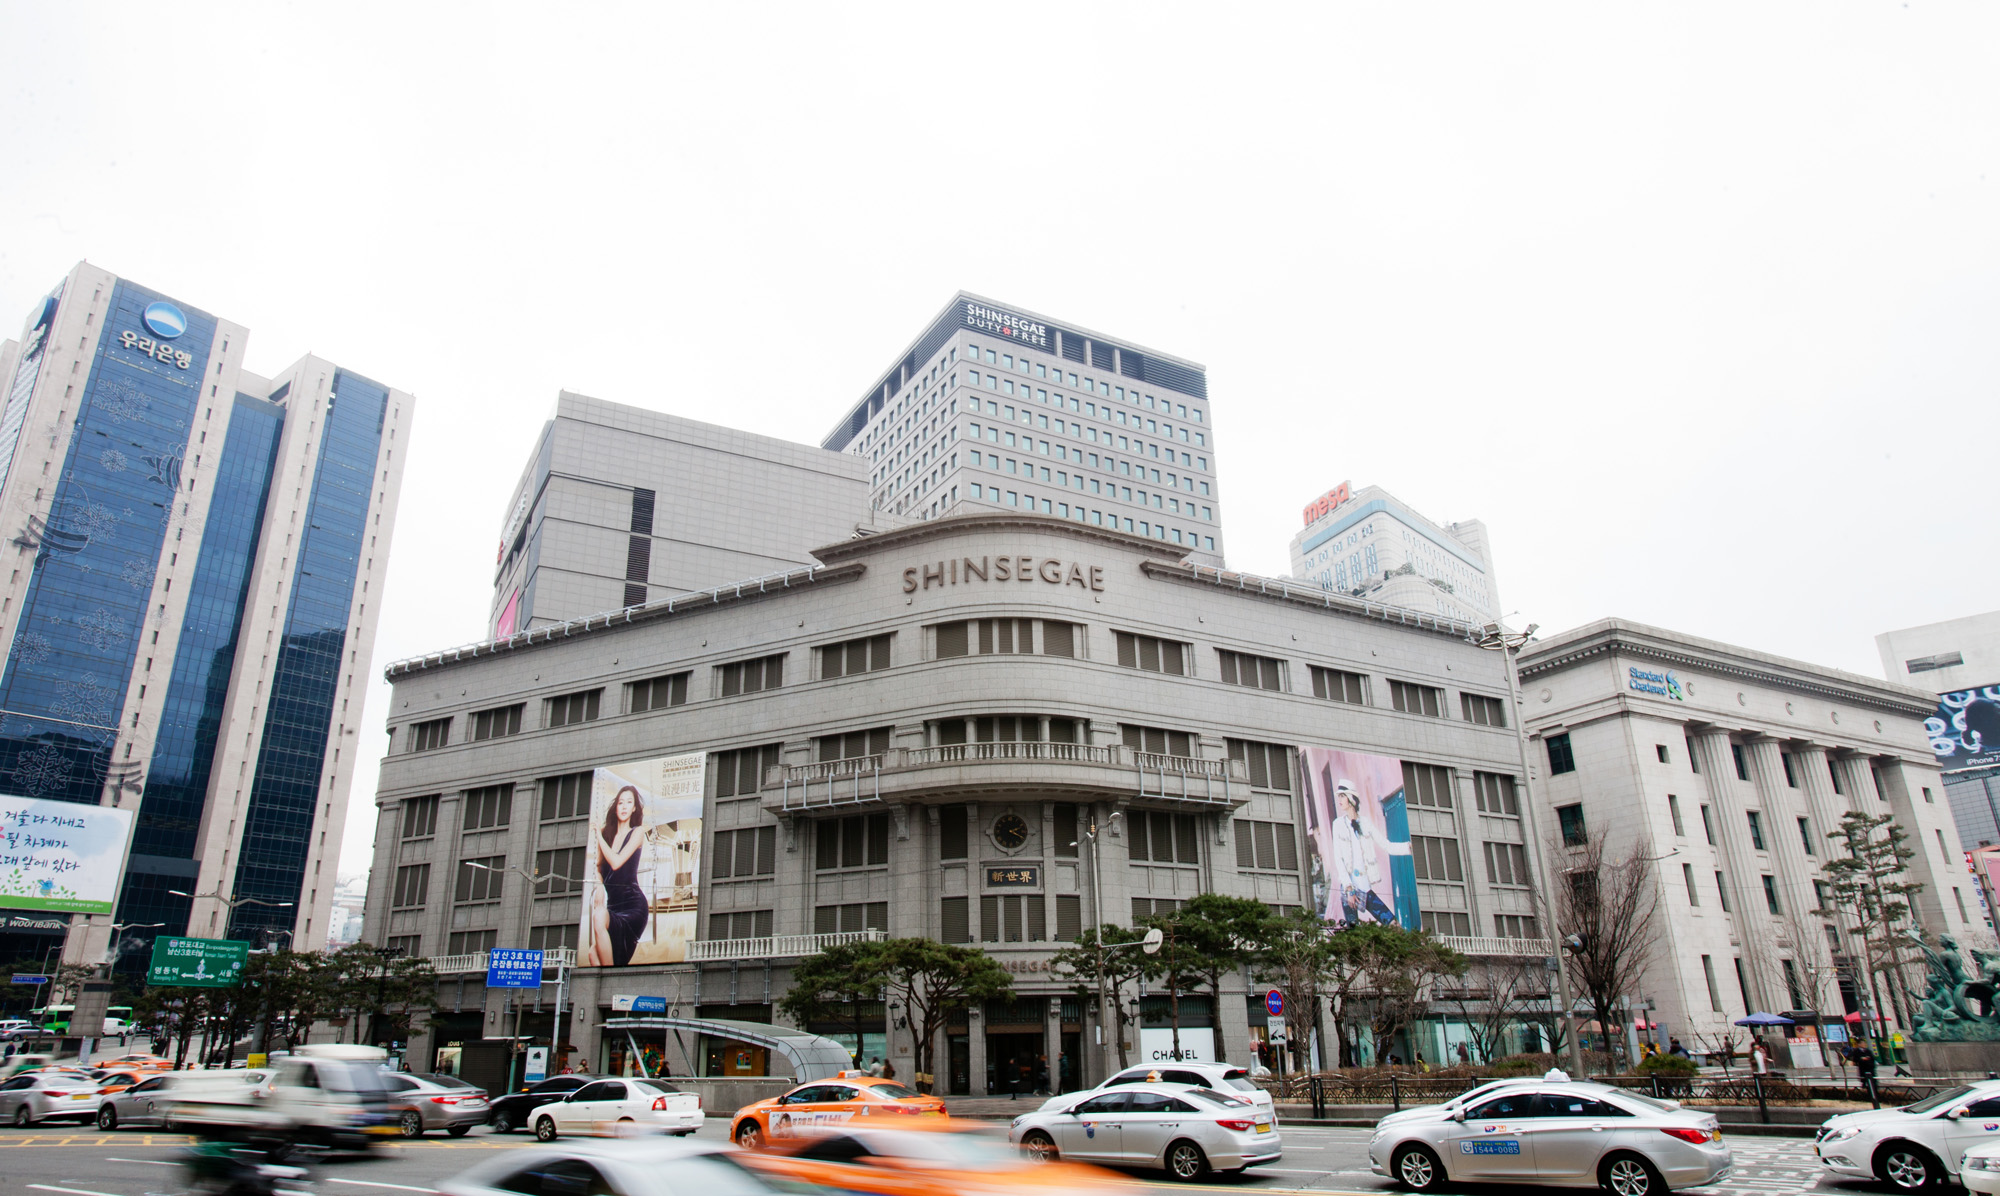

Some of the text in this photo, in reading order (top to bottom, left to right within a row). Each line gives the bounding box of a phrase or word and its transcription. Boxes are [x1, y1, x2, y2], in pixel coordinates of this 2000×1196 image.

[967, 304, 1046, 336] SHINSEGAE
[967, 316, 1046, 346] DUTY FREE
[118, 330, 193, 369] 우리은행
[1303, 482, 1350, 526] mesa
[903, 555, 1105, 593] SHINSEGAE
[1630, 666, 1664, 683] Standard
[1630, 679, 1667, 695] Chartered
[663, 756, 702, 768] SHINSEGAE
[1966, 756, 1994, 765] iPhone
[5, 809, 30, 827] 겨울
[51, 816, 86, 828] 지내고
[24, 834, 69, 849] 차례가
[53, 857, 80, 873] 있다
[991, 871, 1032, 883] 新世界
[1474, 1146, 1519, 1154] 1544-0085
